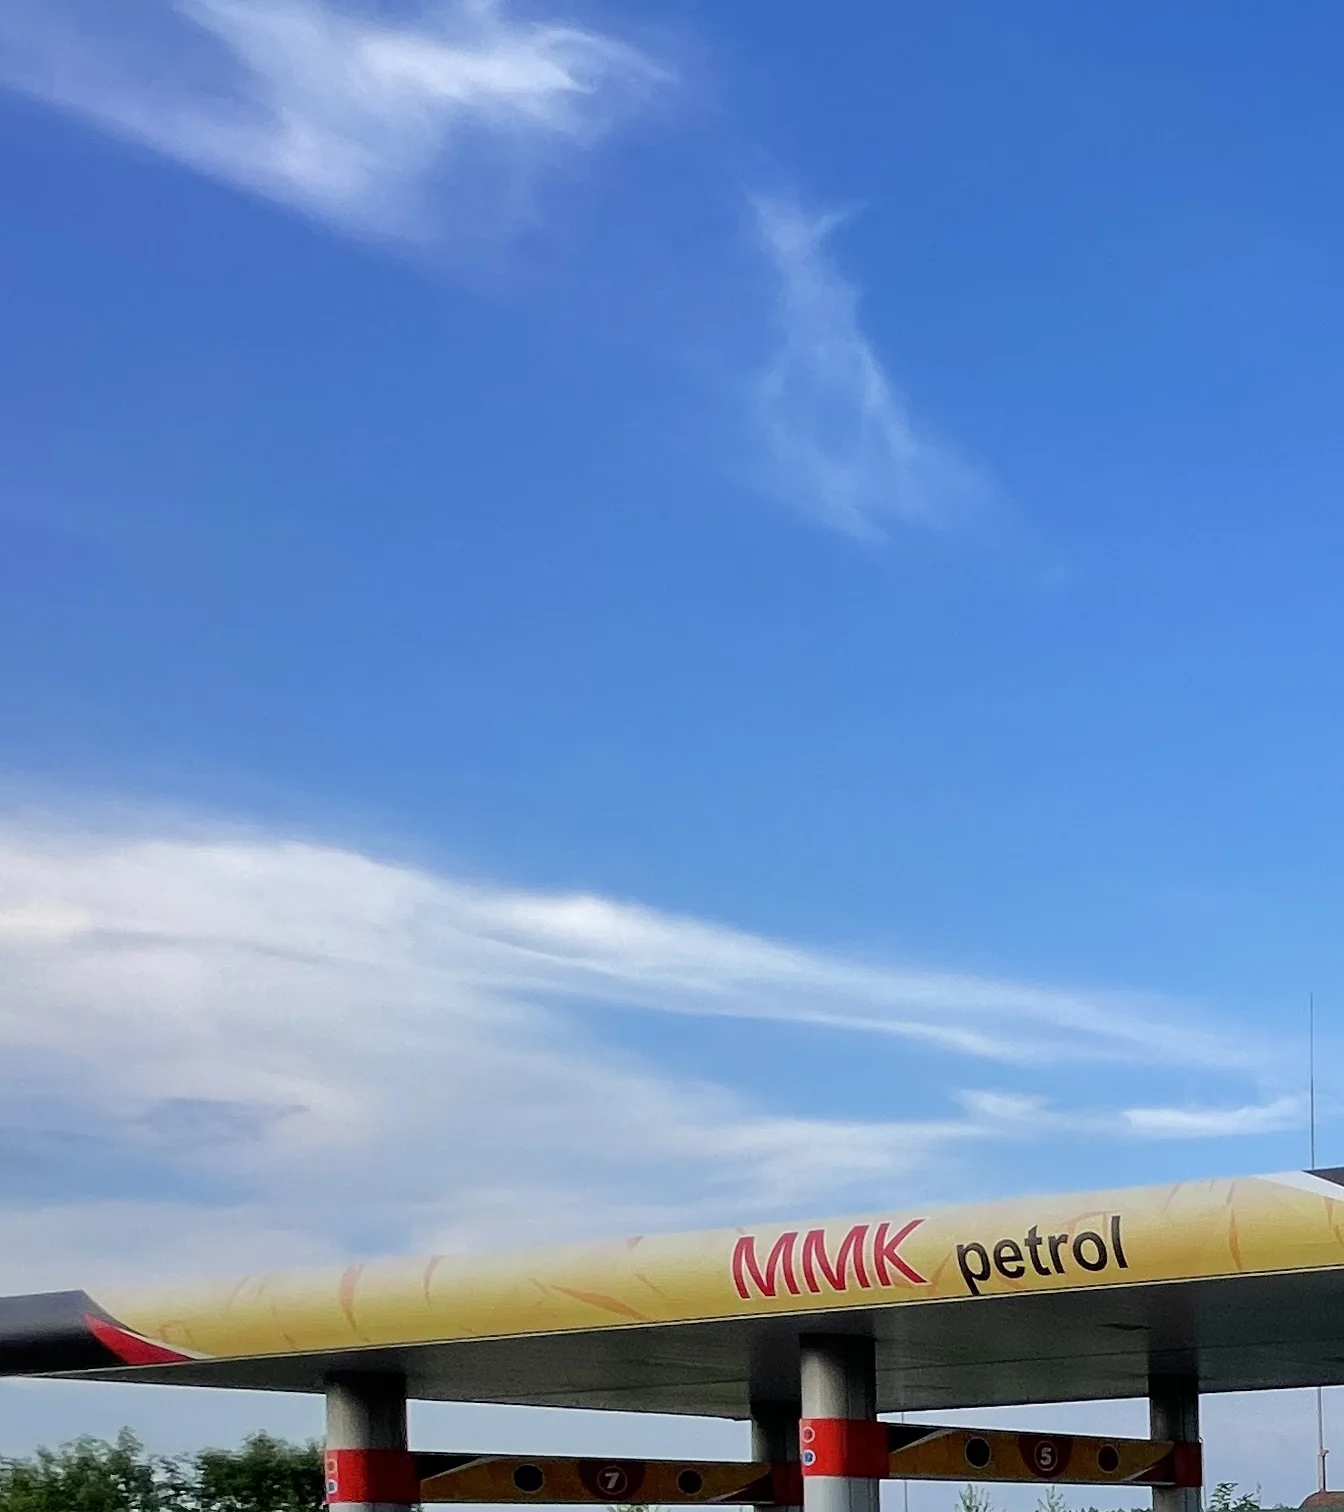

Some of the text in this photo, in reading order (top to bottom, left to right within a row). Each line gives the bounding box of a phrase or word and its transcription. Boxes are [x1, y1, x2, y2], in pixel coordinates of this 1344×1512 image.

[732, 1214, 1129, 1300] MMK petrol
[1039, 1447, 1052, 1465] 5
[604, 1471, 620, 1489] 7
